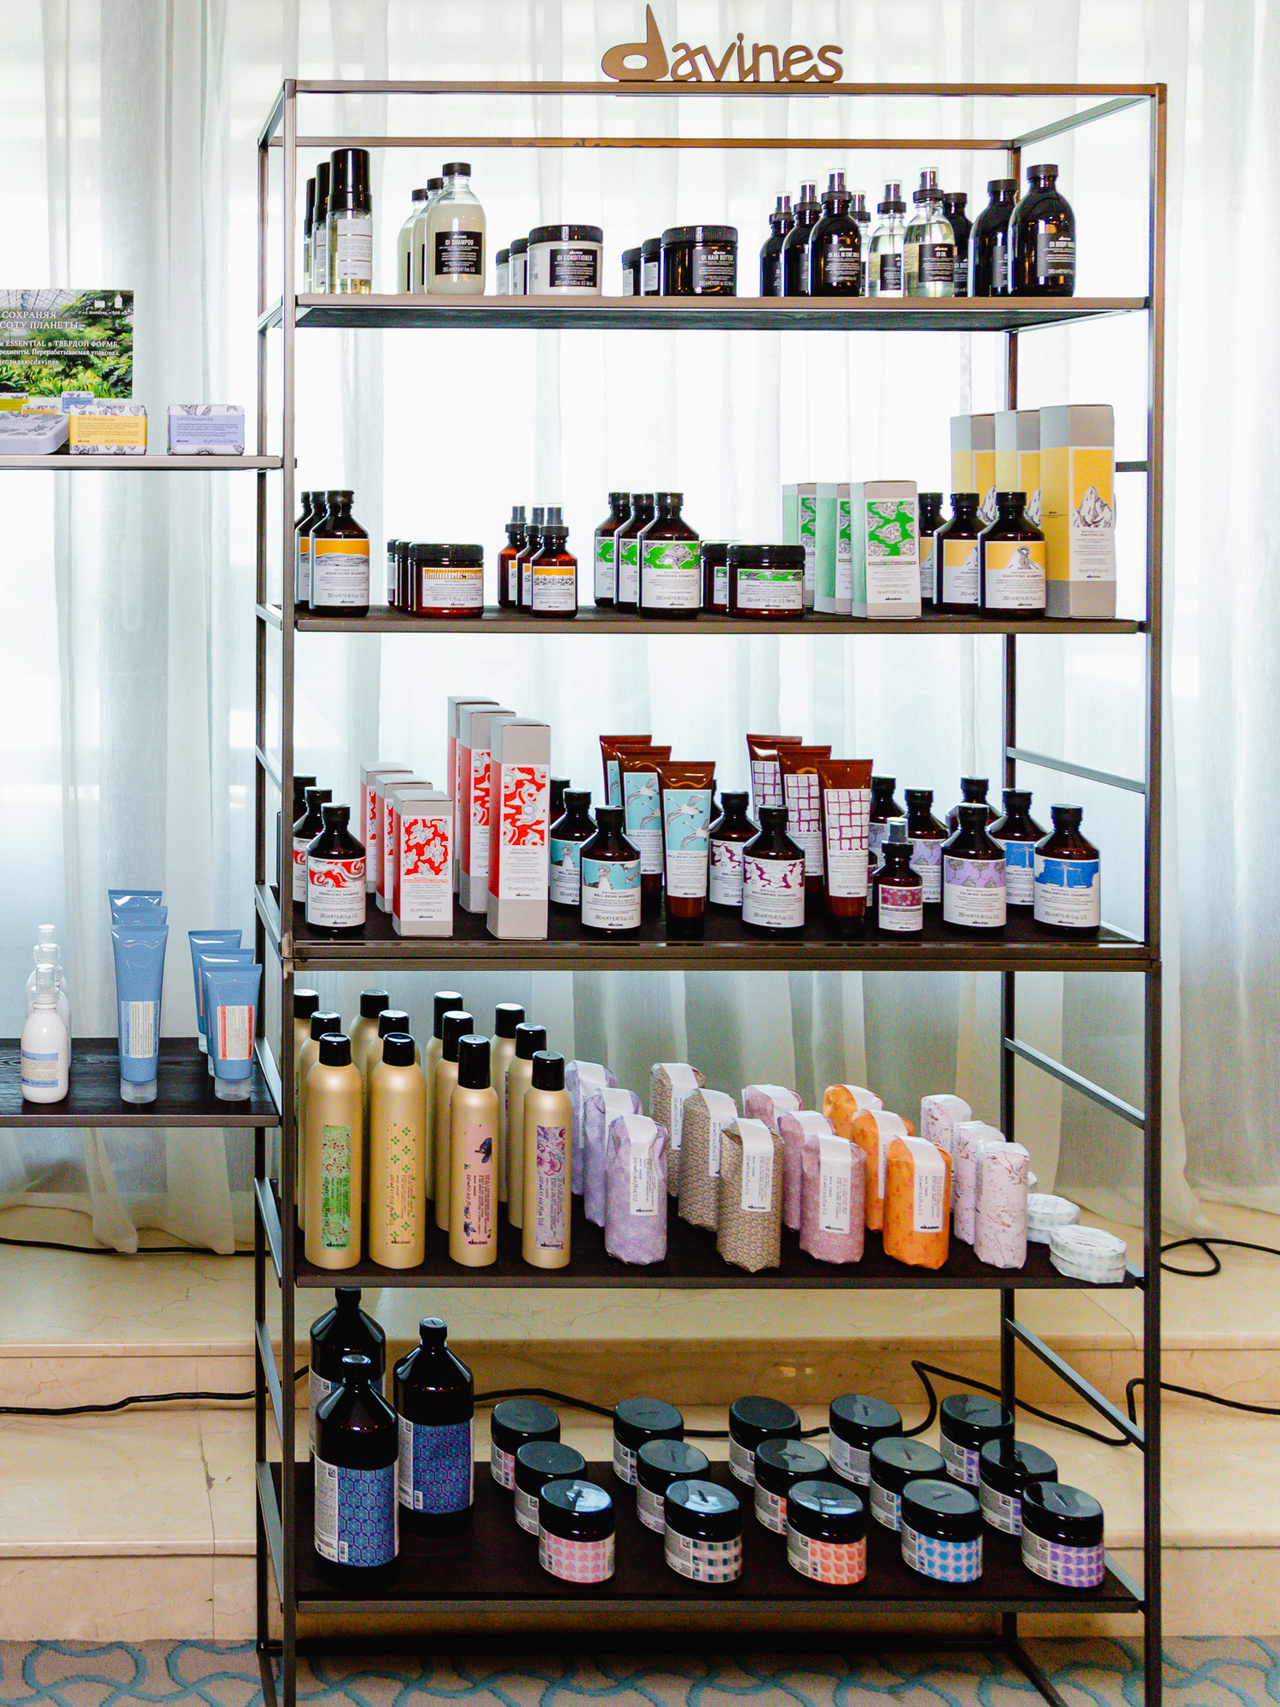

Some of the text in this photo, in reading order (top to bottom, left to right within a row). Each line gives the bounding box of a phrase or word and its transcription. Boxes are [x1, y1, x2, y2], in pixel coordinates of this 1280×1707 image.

[601, 4, 844, 82] davines
[1, 310, 57, 319] СОХРАНЯЯ
[30, 321, 79, 330] ПЛАНЕТЫ
[54, 340, 90, 348] ТВЕРДОЙ
